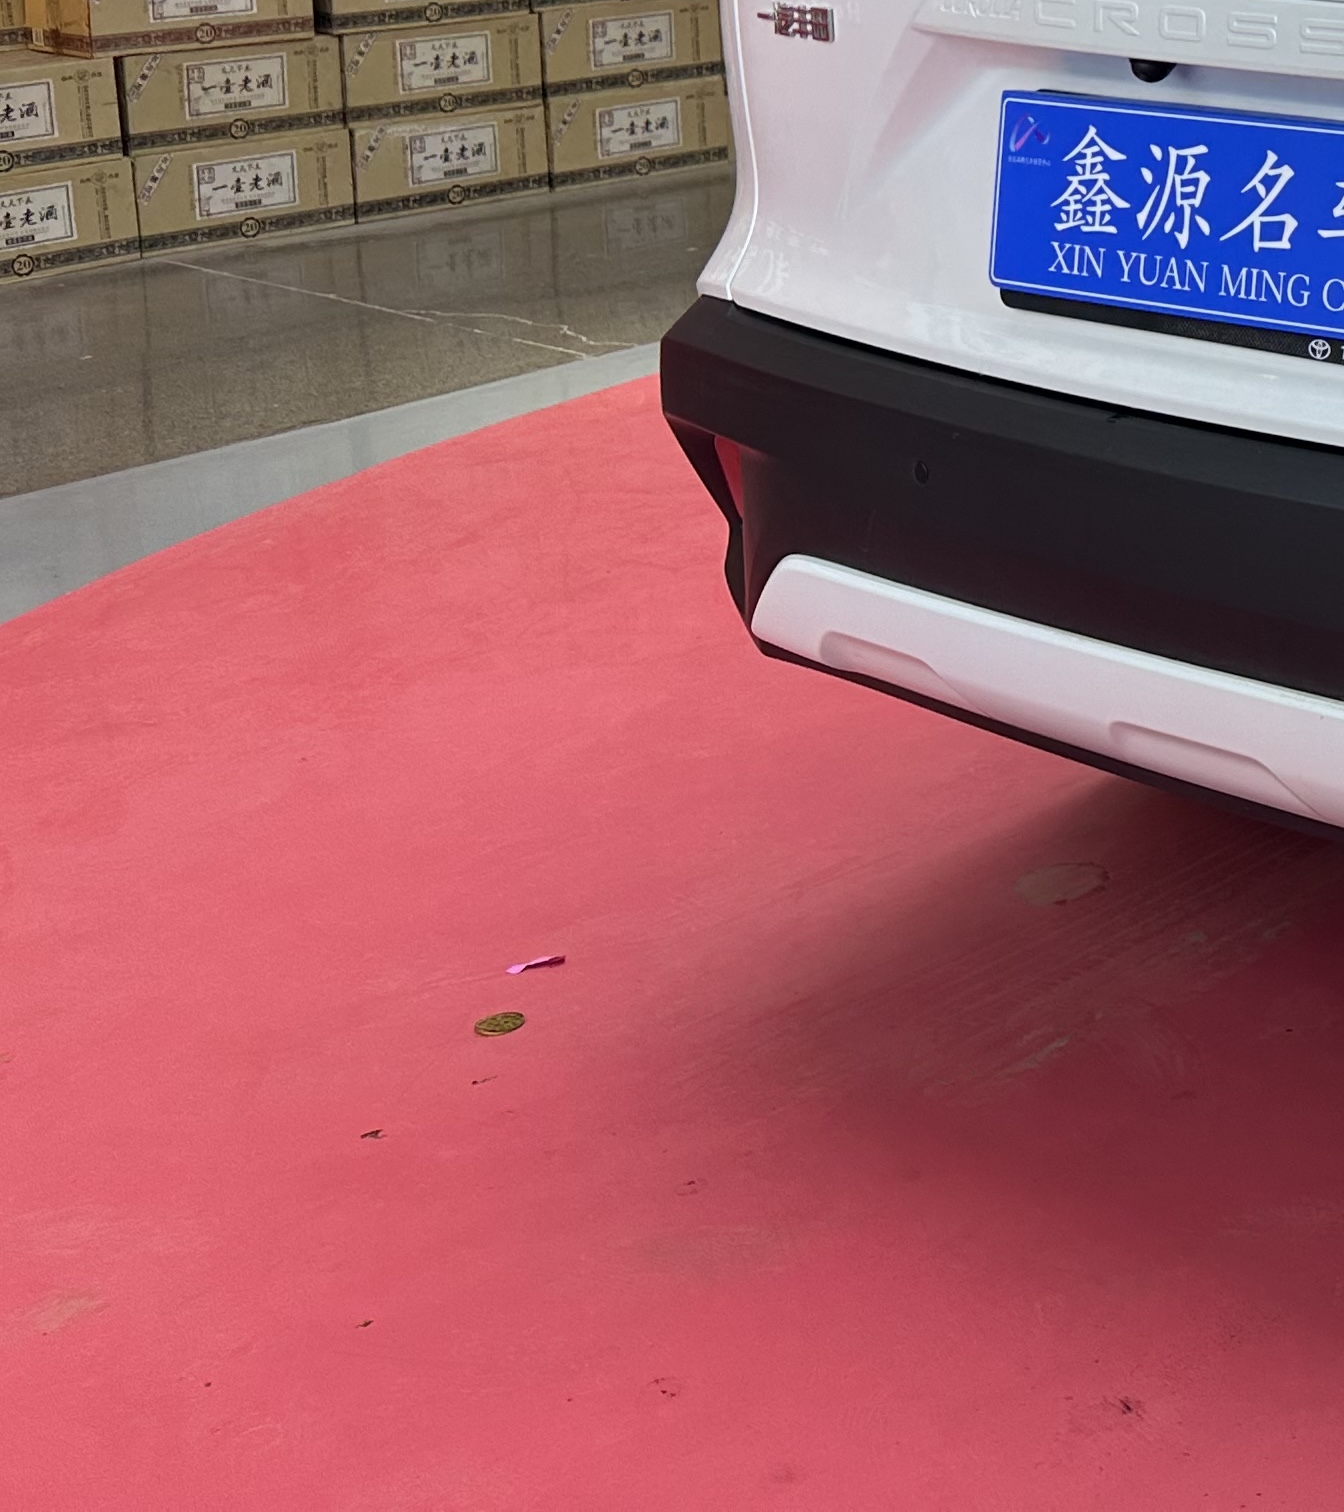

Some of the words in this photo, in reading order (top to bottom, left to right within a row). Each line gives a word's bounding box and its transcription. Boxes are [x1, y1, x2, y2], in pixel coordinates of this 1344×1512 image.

[16, 260, 31, 272] 20
[1047, 240, 1106, 279] XIN
[1116, 249, 1210, 294] YUAN
[1217, 263, 1311, 308] MING
